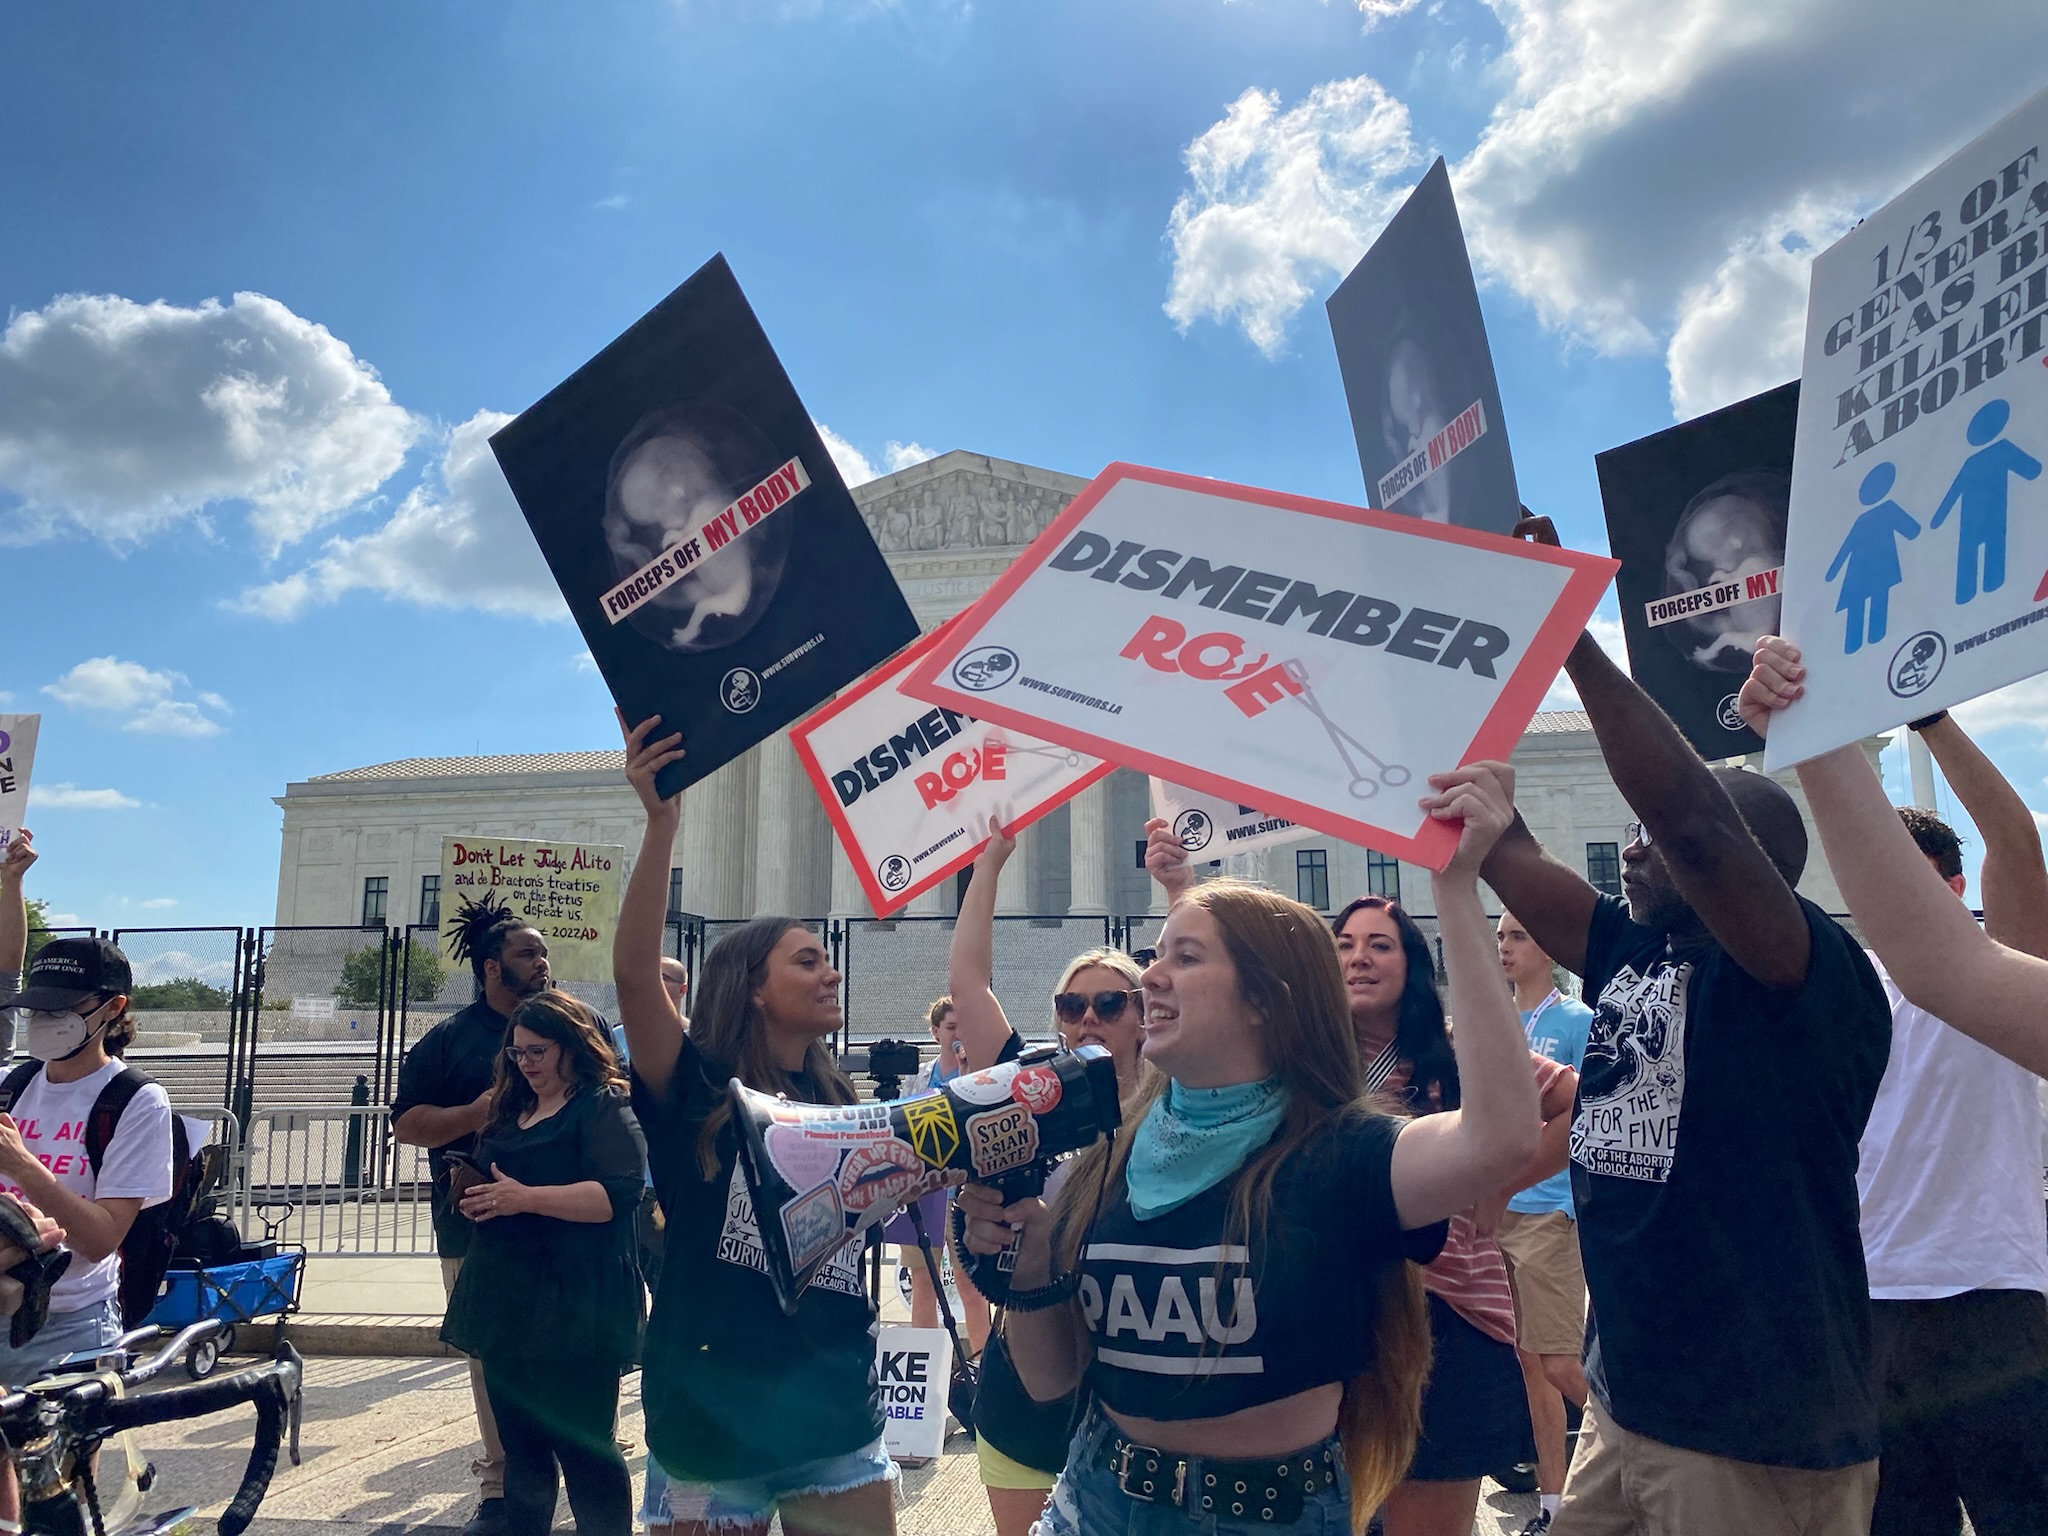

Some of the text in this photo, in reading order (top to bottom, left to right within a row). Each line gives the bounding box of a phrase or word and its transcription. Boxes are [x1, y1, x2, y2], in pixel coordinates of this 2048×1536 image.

[1872, 145, 2039, 292] 1/3 OF
[1856, 221, 2048, 375] HAS B
[1832, 309, 2048, 470] ABORT
[1380, 402, 1482, 502] FORCEPS OFF MY BODY
[607, 462, 801, 616] FORCEPS OFF MY BODY
[917, 581, 975, 596] JUSTICE
[1047, 530, 1511, 681] DISMEMBER
[1650, 569, 1778, 621] FORCEPS OFF MY
[761, 633, 825, 680] WWW.SURVIVORS.LA
[1119, 614, 1305, 719] ROE
[1018, 675, 1123, 715] WWW.SURVIVORS.LA
[914, 744, 1007, 811] ROE
[912, 827, 966, 865] WWW.SURVIVORS.LA
[1226, 818, 1297, 841] www.survi
[453, 843, 493, 866] Don't
[499, 846, 526, 867] Let
[533, 849, 566, 874] Judge
[455, 865, 600, 893] and de Bracton's treatise
[513, 889, 583, 907] on the fetus
[523, 901, 583, 921] defeat us.
[859, 1118, 887, 1131] AND
[977, 1113, 1021, 1144] STOP
[1591, 1089, 1660, 1134] FOR THE
[804, 1129, 891, 1140] Planned Parenthood
[981, 1128, 1029, 1158] ASIAN
[1629, 1115, 1679, 1149] FIVE
[986, 1147, 1027, 1172] HATE
[1597, 1149, 1608, 1161] OF
[1609, 1151, 1628, 1164] THE
[1597, 1162, 1655, 1179] HOLOCAUST
[818, 1265, 830, 1277] HE
[1078, 1274, 1258, 1345] PAAU
